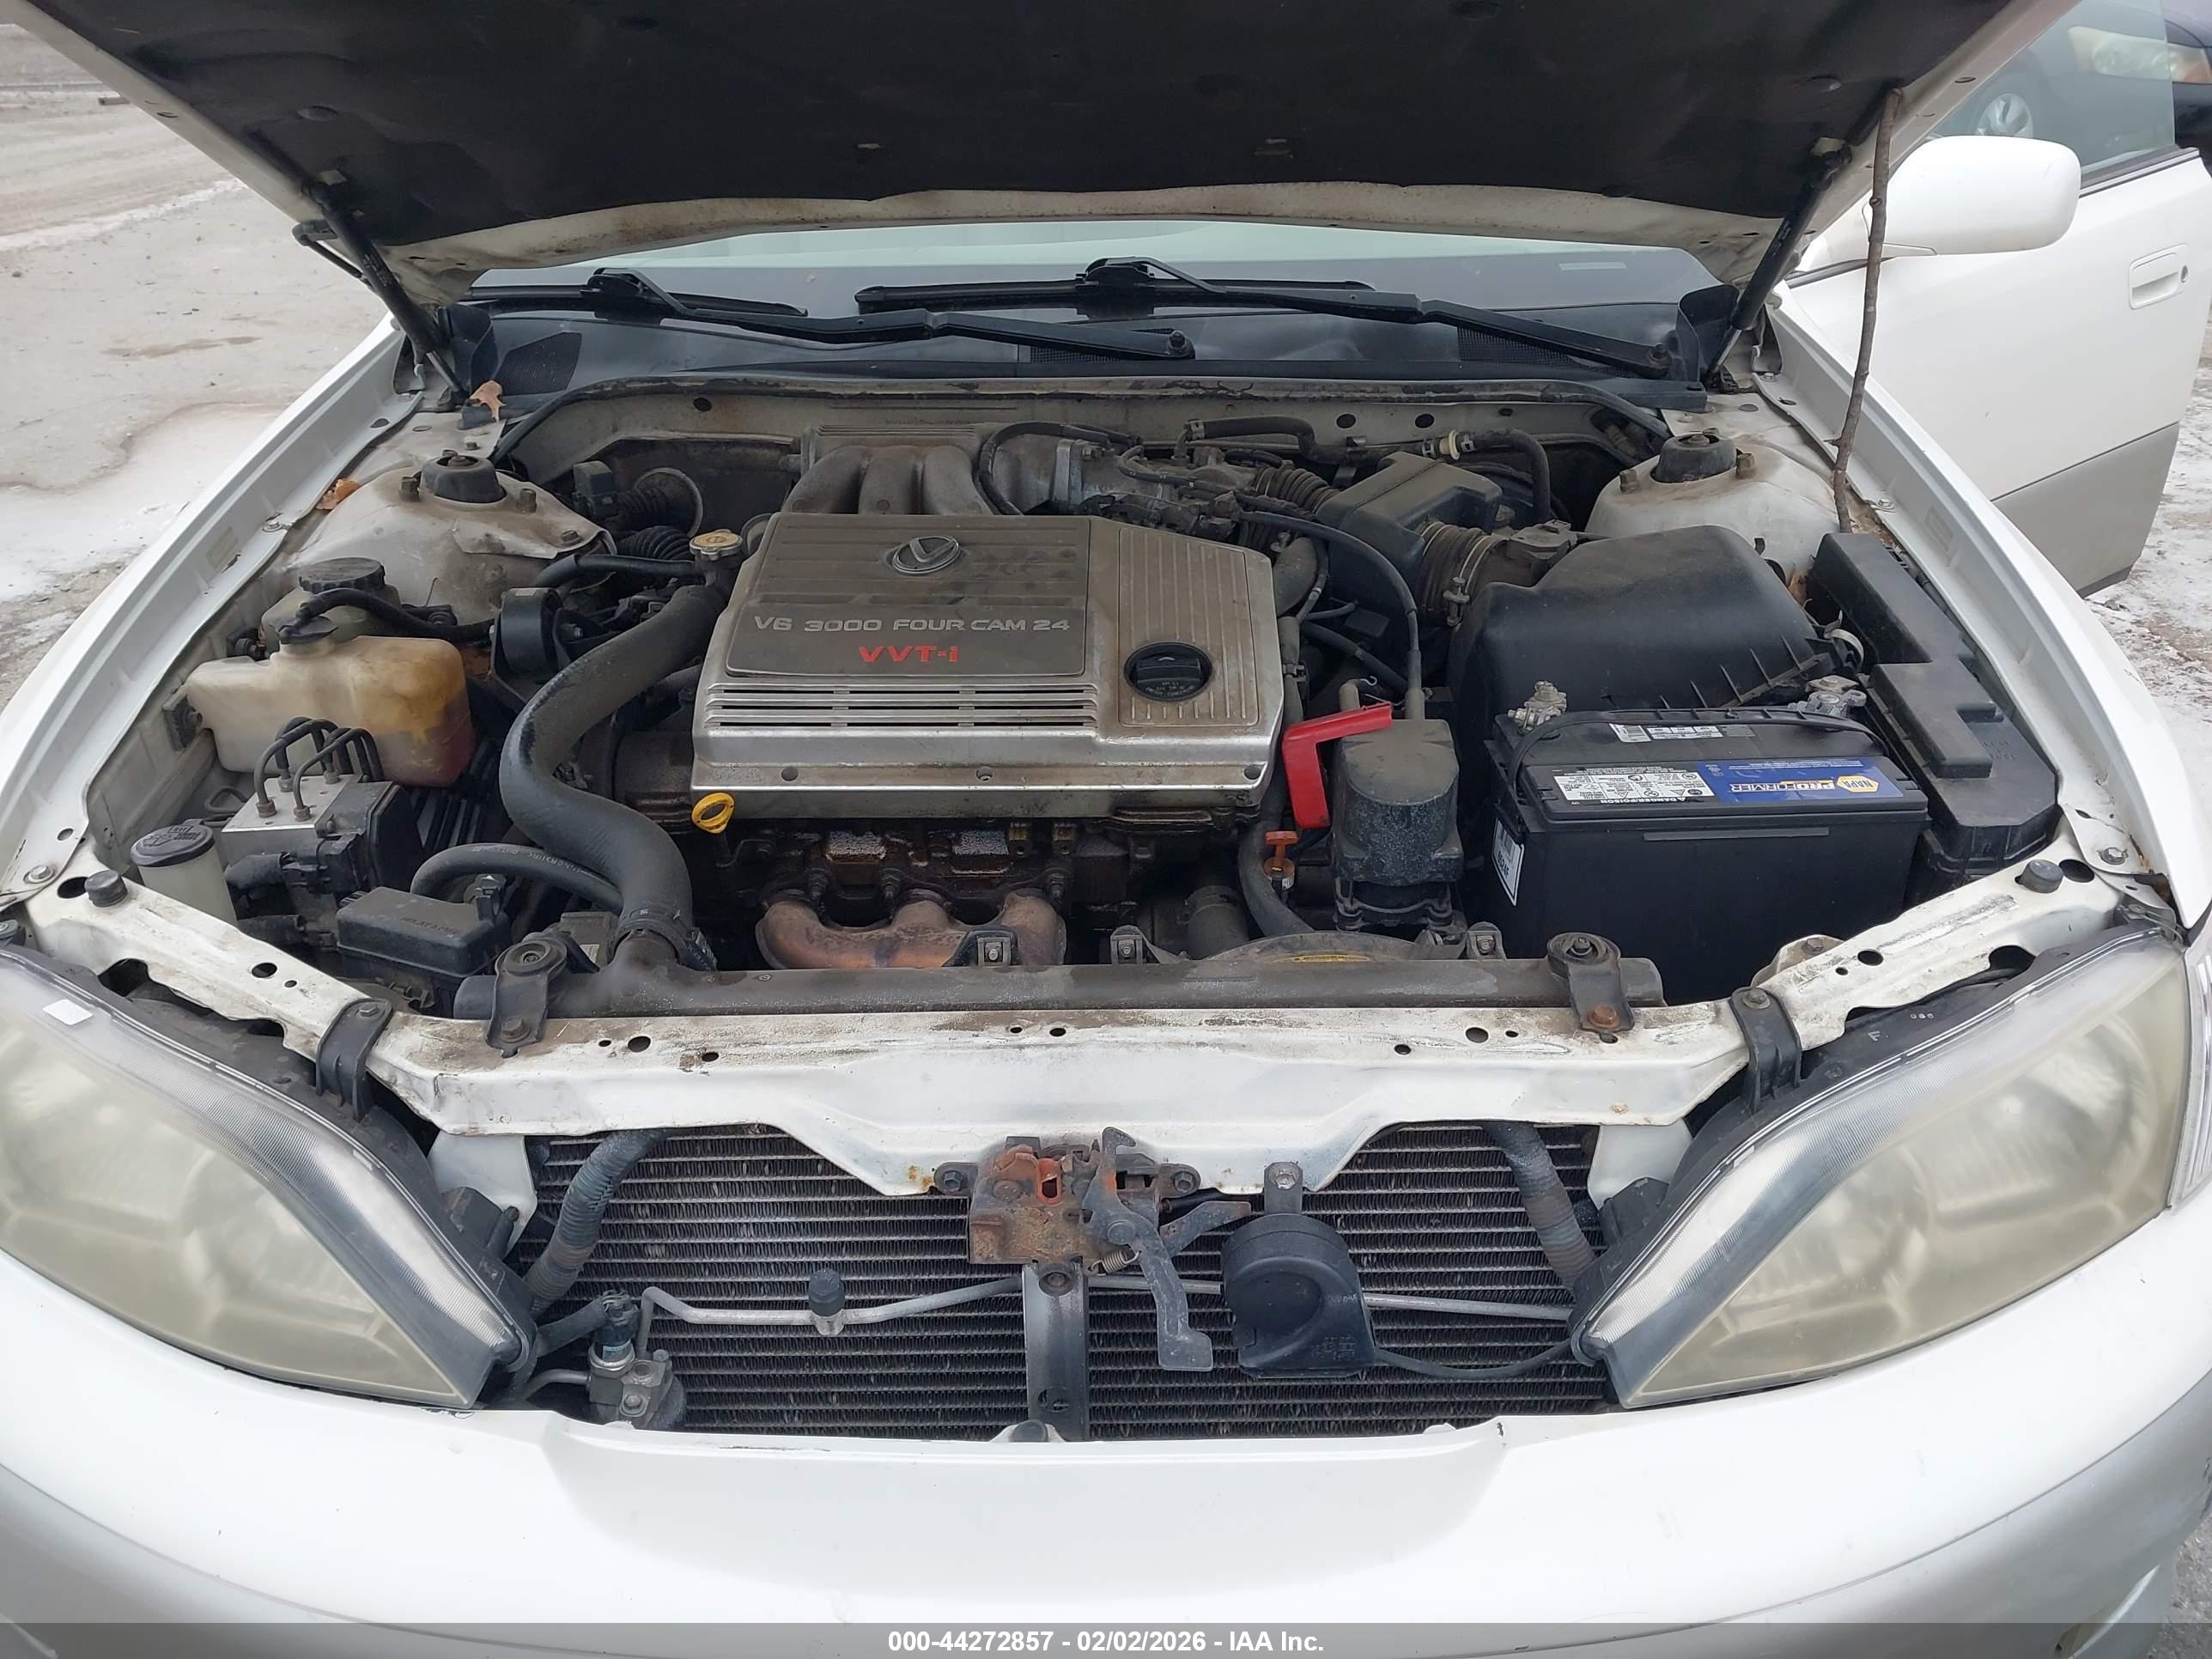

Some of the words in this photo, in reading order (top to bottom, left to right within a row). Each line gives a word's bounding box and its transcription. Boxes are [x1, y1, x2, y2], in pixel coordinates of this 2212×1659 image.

[754, 616, 793, 631] V6
[804, 618, 883, 632] 3000
[892, 618, 966, 631] FOUR
[971, 619, 1026, 631] CAM
[1032, 619, 1070, 631] 24
[859, 645, 959, 663] VVT-i
[1729, 782, 1835, 793] PROFORMER
[1840, 779, 1874, 788] NAPA
